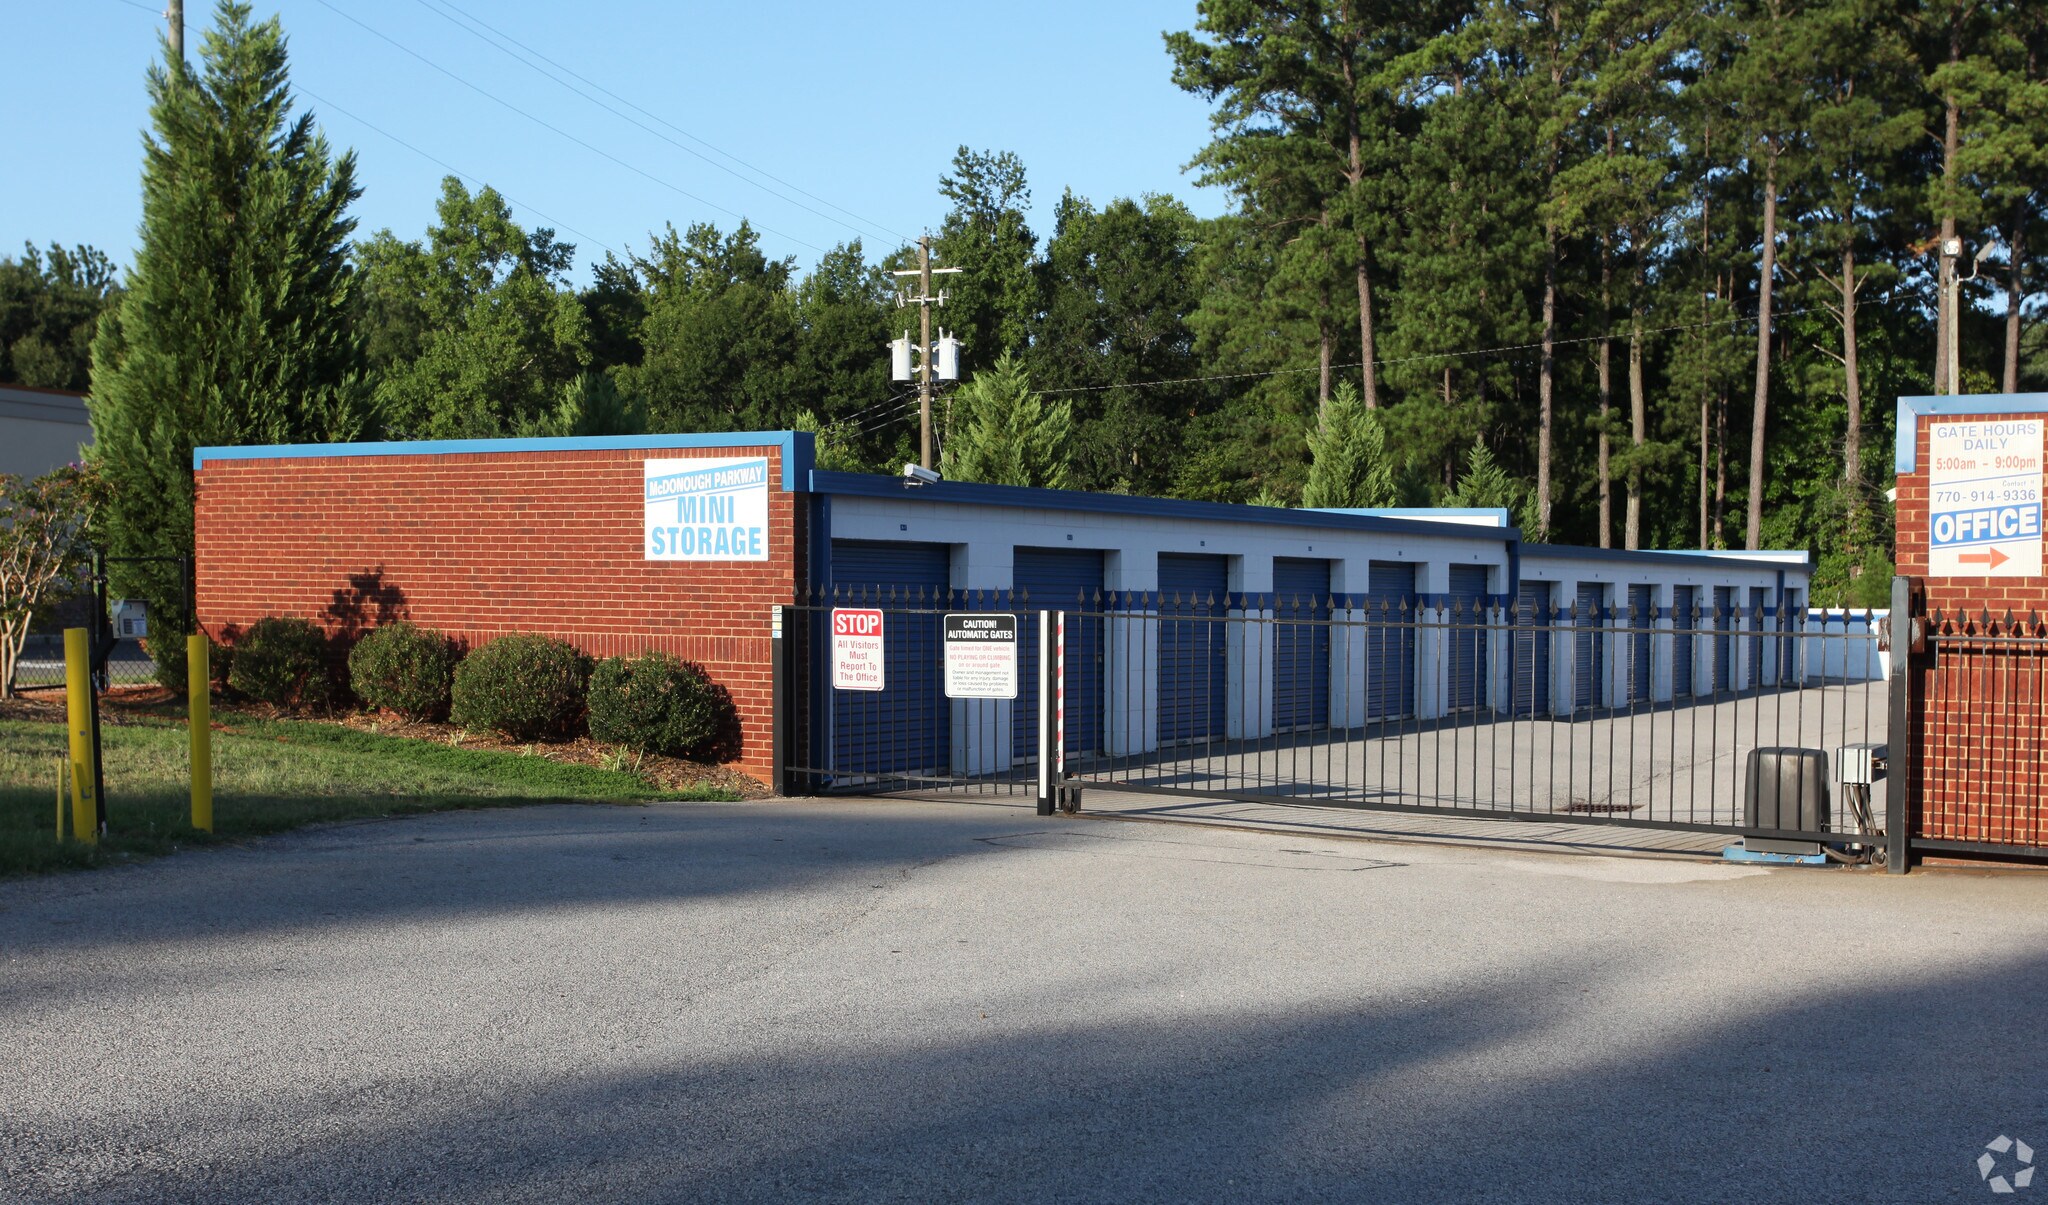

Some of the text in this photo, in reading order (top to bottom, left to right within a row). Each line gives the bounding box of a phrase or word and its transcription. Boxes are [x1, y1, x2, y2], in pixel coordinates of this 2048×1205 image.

[1937, 423, 2037, 438] GATE HOURS
[1964, 438, 2008, 451] DAILY
[1936, 457, 1976, 471] 5:00am
[1995, 455, 2036, 471] 9:00pm
[649, 465, 763, 497] McDONOUGH PARKWAY
[677, 495, 735, 524] MINI
[1934, 505, 2038, 543] OFFICE
[651, 526, 761, 556] STORAGE
[836, 613, 879, 634] STOP
[963, 619, 997, 629] CAUTION!
[947, 630, 1013, 639] AUTOMATIC GATES
[837, 640, 879, 650] All Visitors
[849, 651, 868, 660] Must
[840, 661, 877, 672] Report To
[840, 672, 878, 682] The Office
